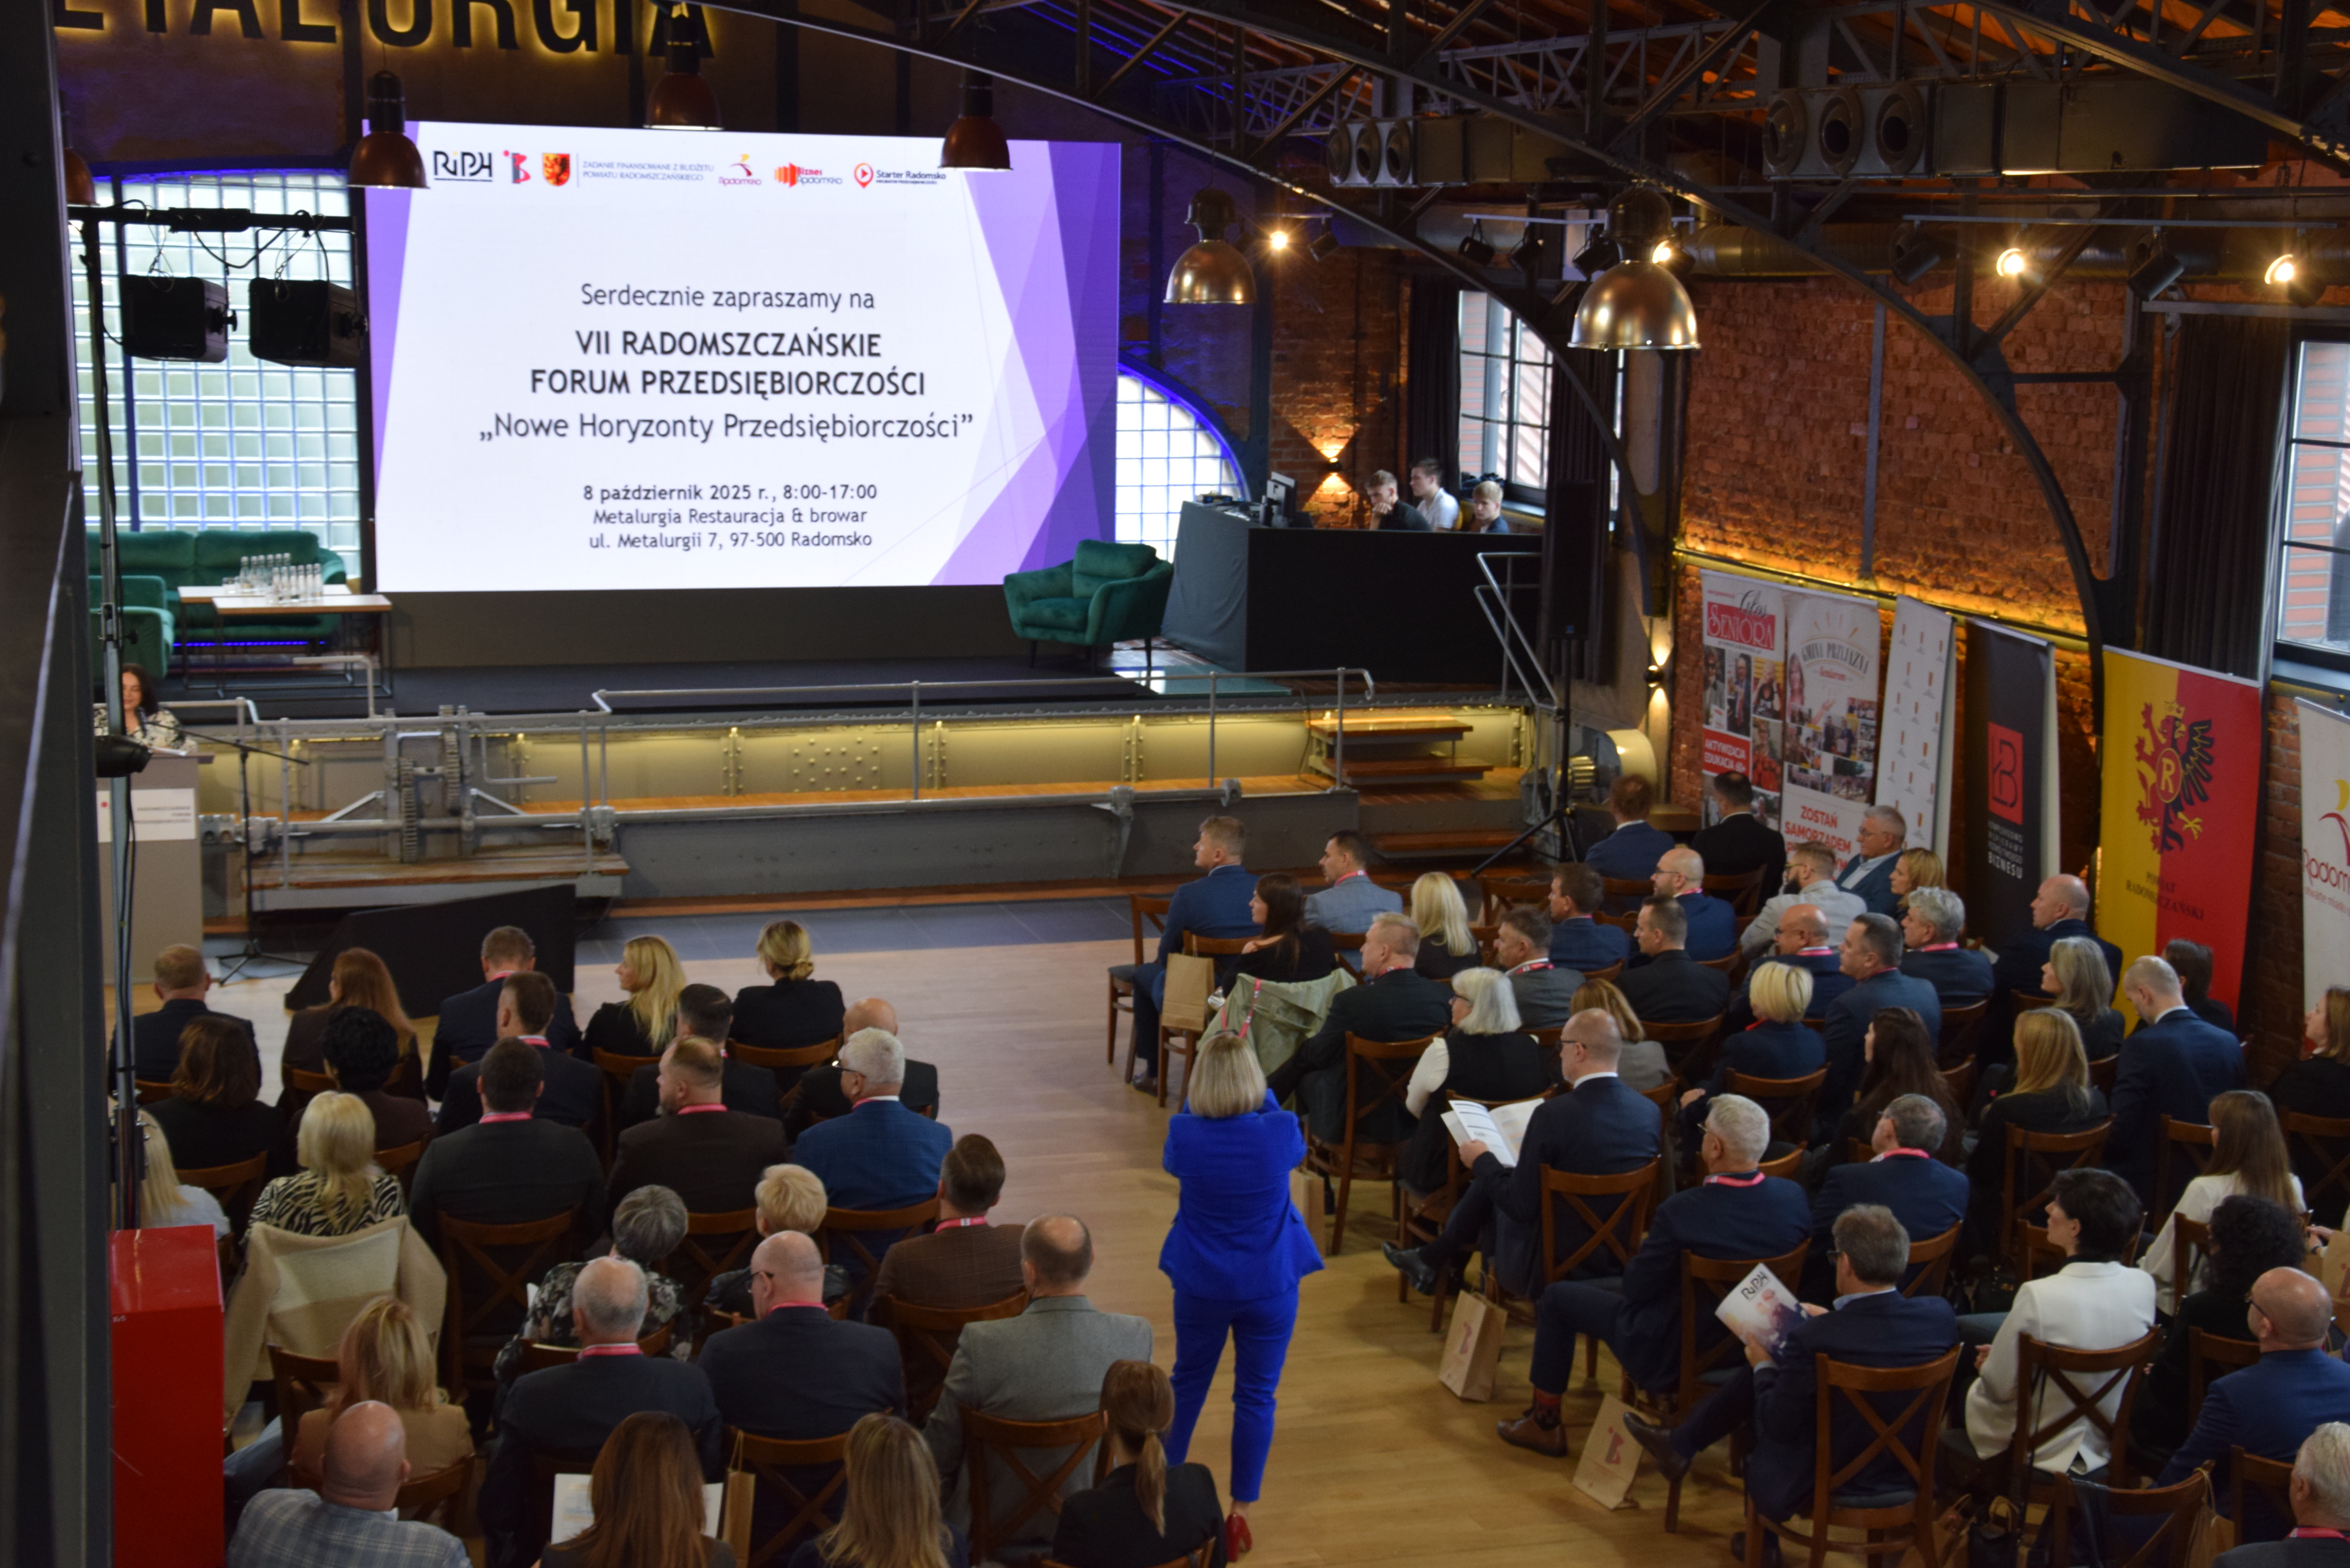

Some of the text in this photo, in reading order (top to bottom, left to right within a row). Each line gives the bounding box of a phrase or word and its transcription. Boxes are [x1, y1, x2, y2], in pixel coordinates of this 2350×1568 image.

[617, 162, 671, 170] FINANSOWANE
[877, 170, 946, 179] Starter Radomsko
[581, 283, 875, 313] Serdecznie zapraszamy na
[575, 327, 882, 358] VII RADOMSZCZAŃSKIE
[531, 366, 925, 400] FORUM PRZEDSIĘBIORCZOŚCI
[479, 412, 973, 443] „Nowe Horyzonty Przedsiębiorczości”
[584, 484, 877, 504] 8 październik 2025 r., 8:00-17:00
[594, 508, 868, 528] Metalurgia Restauracja & browar
[590, 531, 872, 551] ul. Metalurgii 7, 97-500 Radomsko
[1801, 805, 1838, 829] ZOSTAŃ
